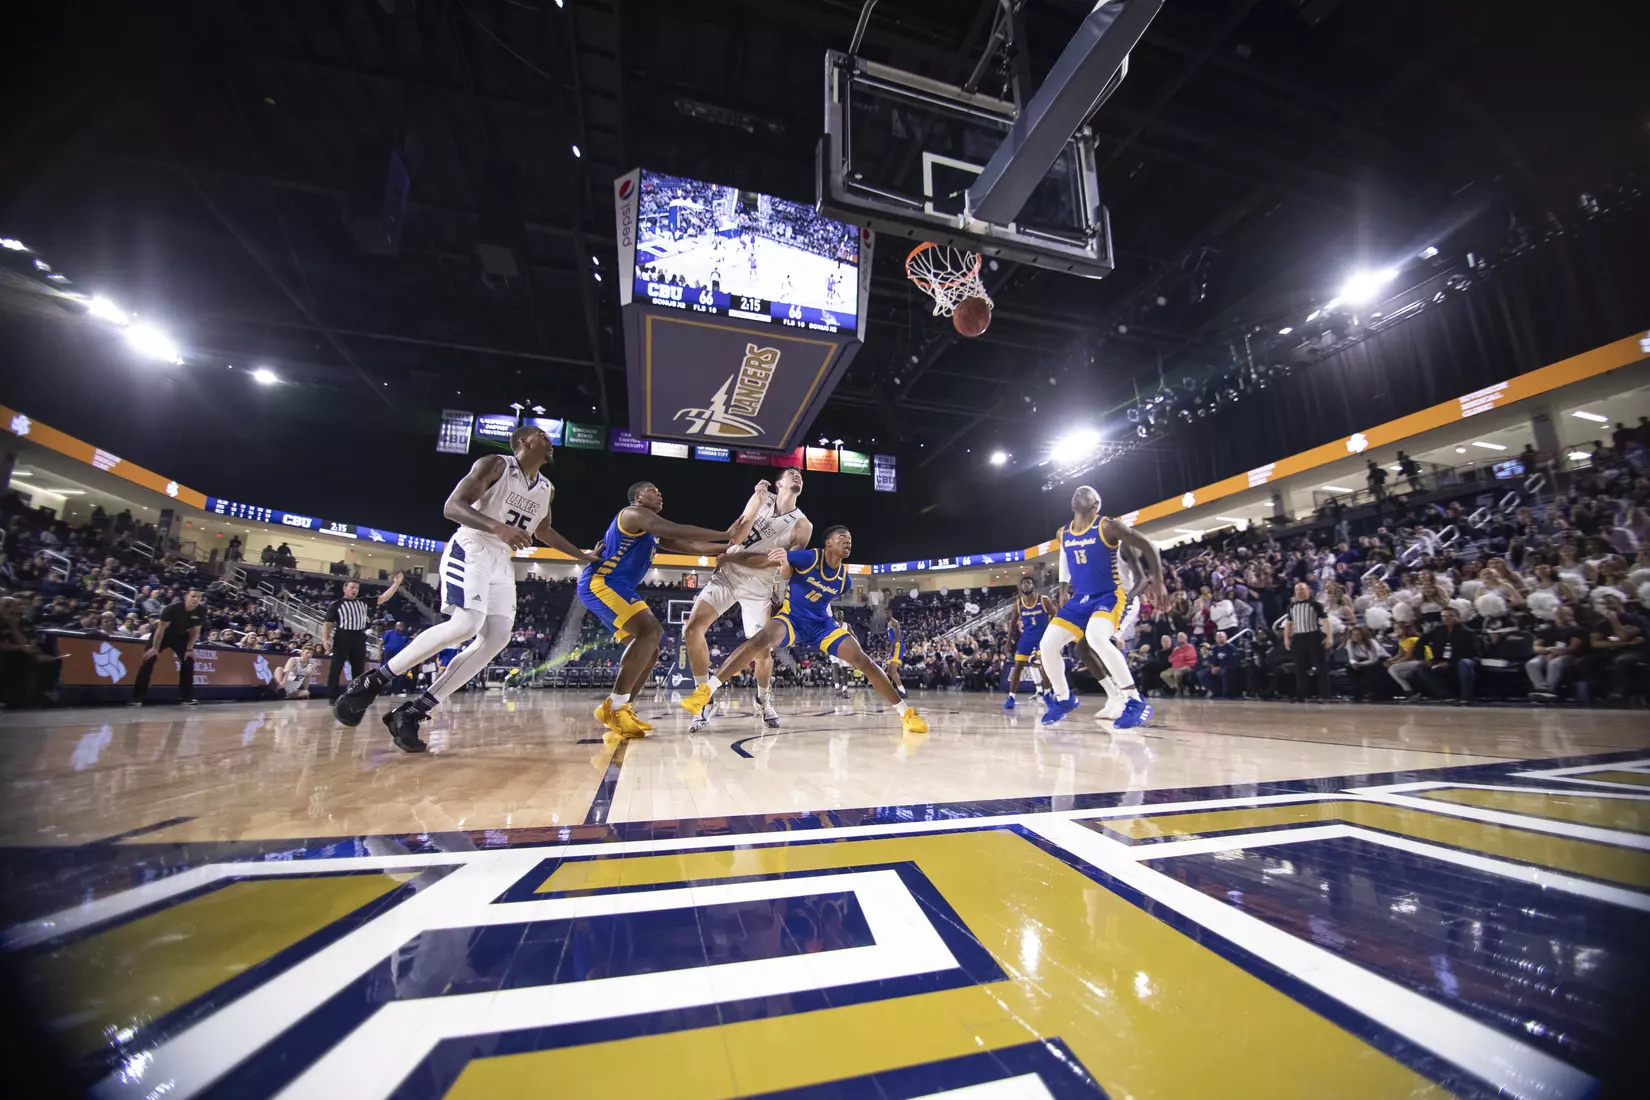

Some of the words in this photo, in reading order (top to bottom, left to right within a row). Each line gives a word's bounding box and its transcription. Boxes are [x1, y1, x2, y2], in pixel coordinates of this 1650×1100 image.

[621, 201, 633, 247] pepsi
[647, 282, 683, 300] CBU
[699, 290, 713, 305] 66
[740, 297, 761, 312] 2:15
[788, 305, 802, 319] 66
[728, 343, 781, 417] LANCERS
[569, 437, 600, 445] UNIVERSITY
[282, 514, 312, 528] CBU
[330, 522, 348, 533] 2:15
[1073, 549, 1088, 564] 13
